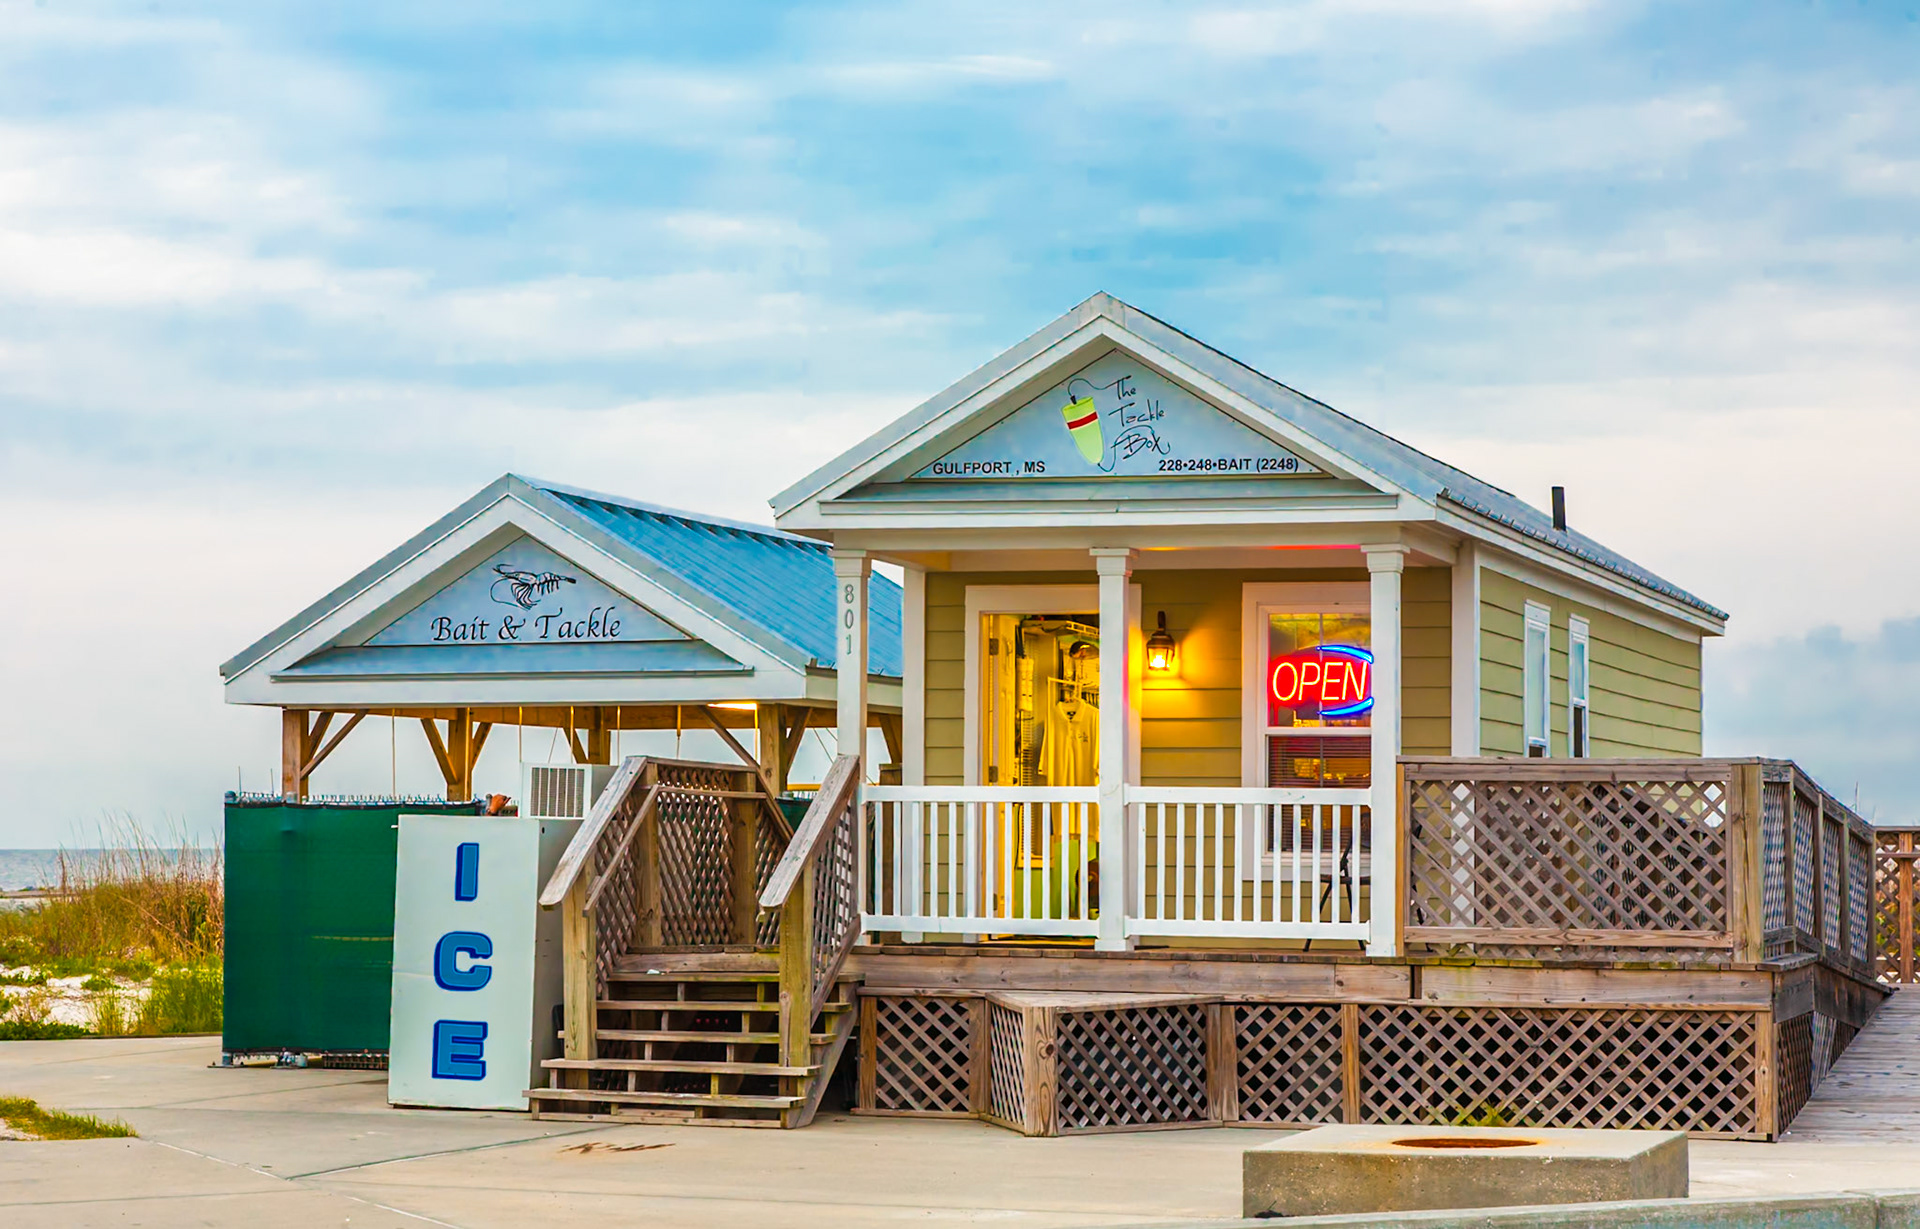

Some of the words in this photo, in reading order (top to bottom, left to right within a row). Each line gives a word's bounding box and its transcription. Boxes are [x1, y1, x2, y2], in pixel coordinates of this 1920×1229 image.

[1106, 375, 1137, 400] The
[1108, 399, 1165, 427] Tackle
[1110, 427, 1171, 460] Box
[1024, 460, 1046, 473] MS
[1256, 457, 1299, 473] (2248)
[430, 616, 490, 641] Bait
[498, 615, 526, 640] &
[534, 606, 621, 640] Tackle
[844, 583, 855, 656] 801
[1271, 660, 1369, 702] OPEN
[432, 842, 493, 1081] ICE
